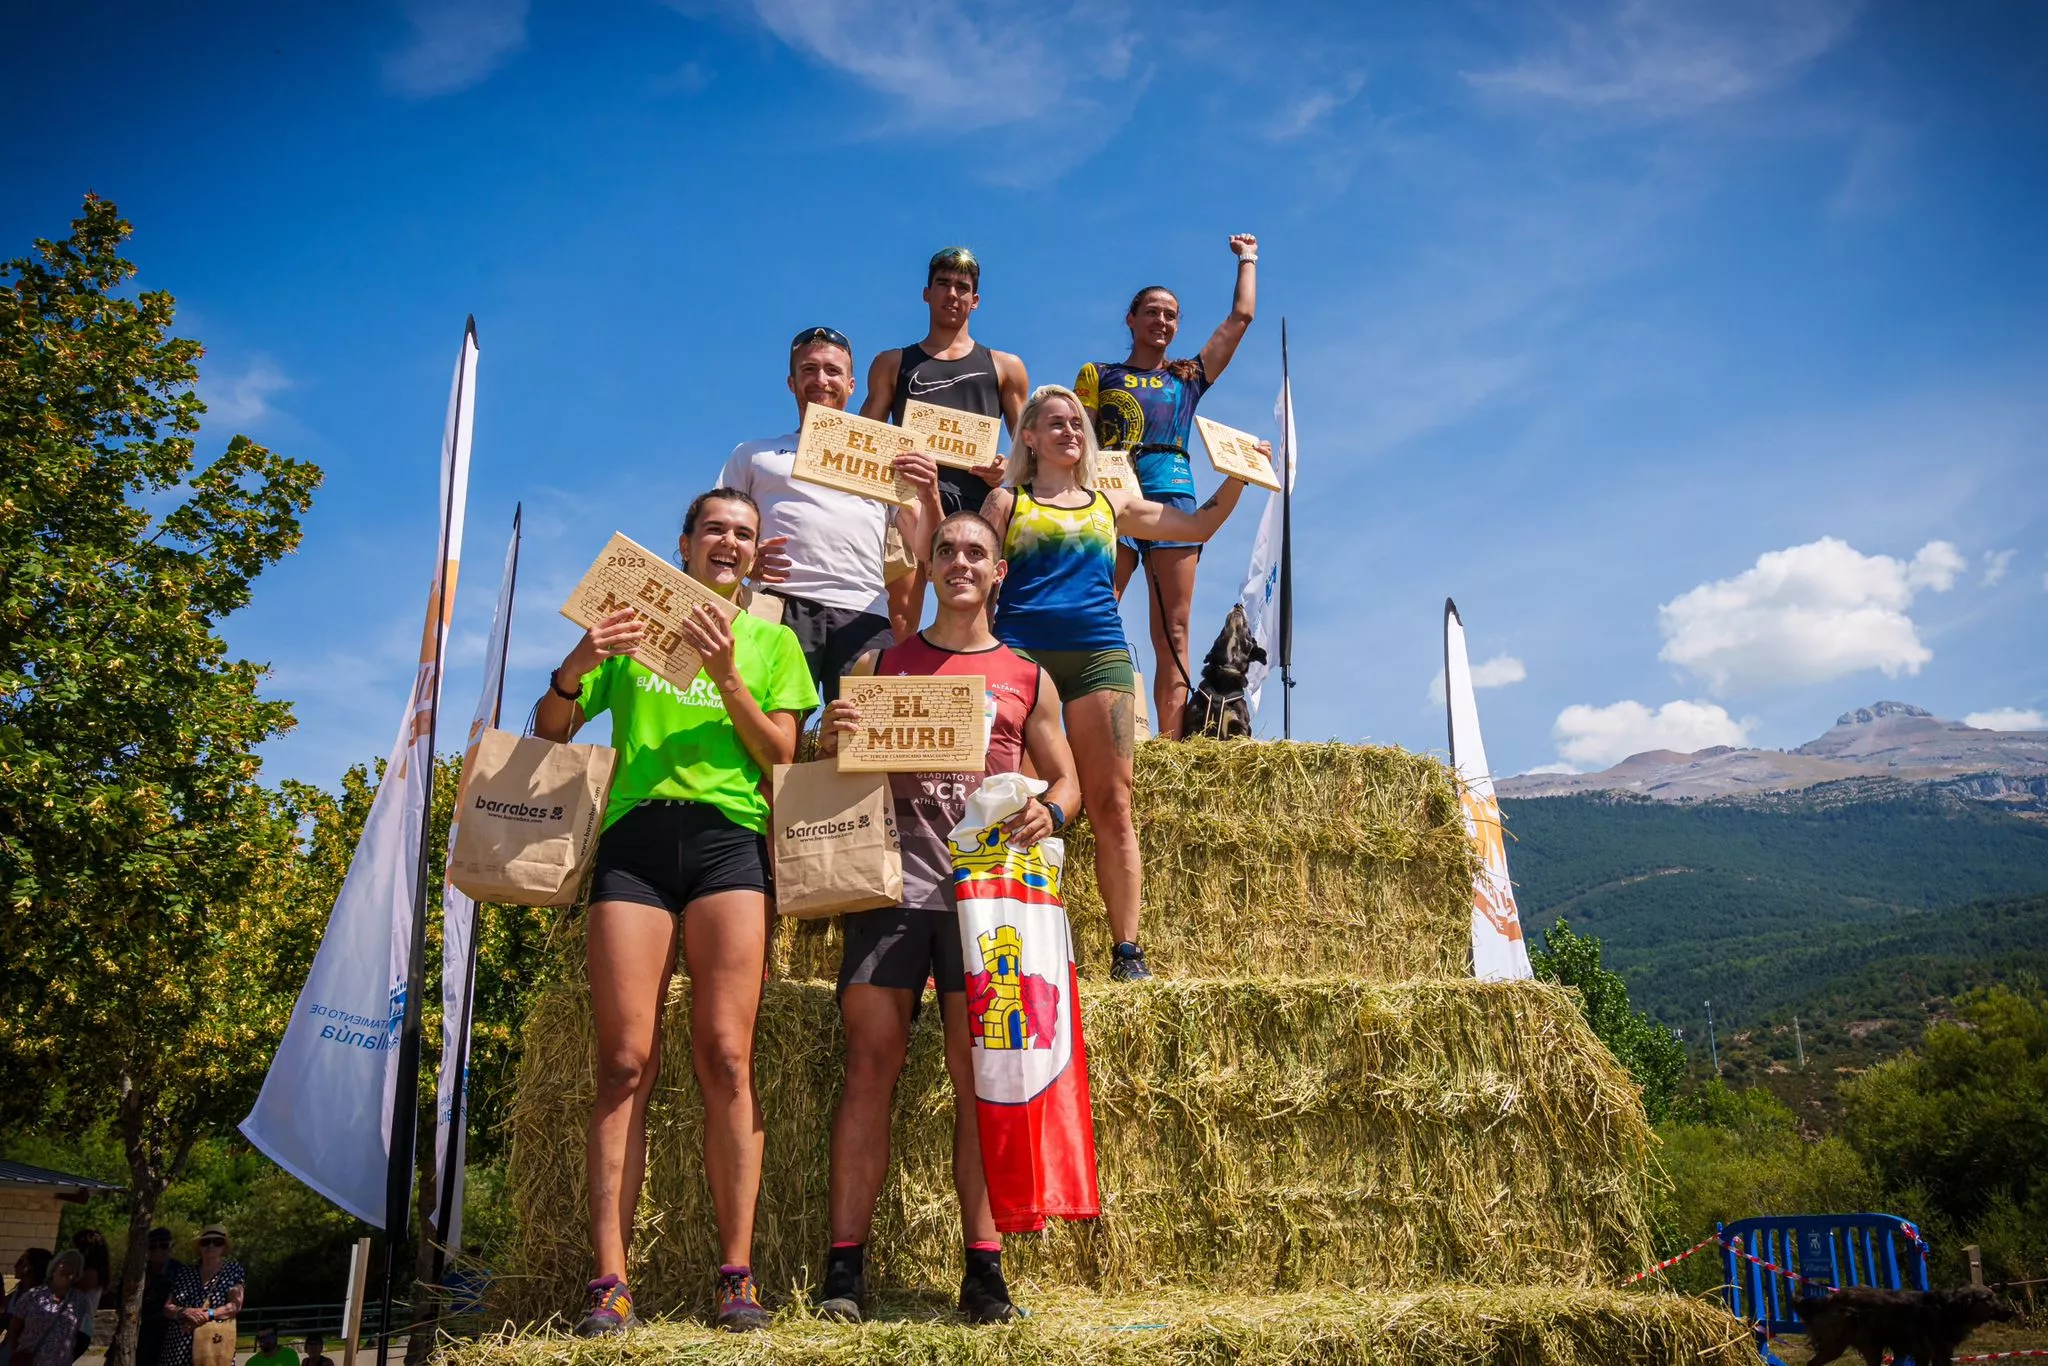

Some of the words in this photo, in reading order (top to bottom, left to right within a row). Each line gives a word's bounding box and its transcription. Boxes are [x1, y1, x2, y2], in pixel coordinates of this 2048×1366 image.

[911, 408, 935, 420] 2023
[812, 417, 844, 431] 2023
[938, 418, 963, 435] EL
[846, 430, 878, 455] EL
[820, 449, 896, 485] MURO
[607, 556, 646, 569] 2023
[636, 577, 674, 615] EL
[597, 592, 682, 655] MRO
[636, 676, 650, 688] EL
[991, 683, 1020, 694] ALTAFIT
[849, 684, 884, 708] 2023
[952, 687, 970, 697] on
[892, 696, 929, 718] EL
[867, 727, 955, 750] MURO
[916, 772, 976, 784] GLADIATORS
[475, 795, 548, 818] barrabes
[786, 820, 855, 839] barrabes
